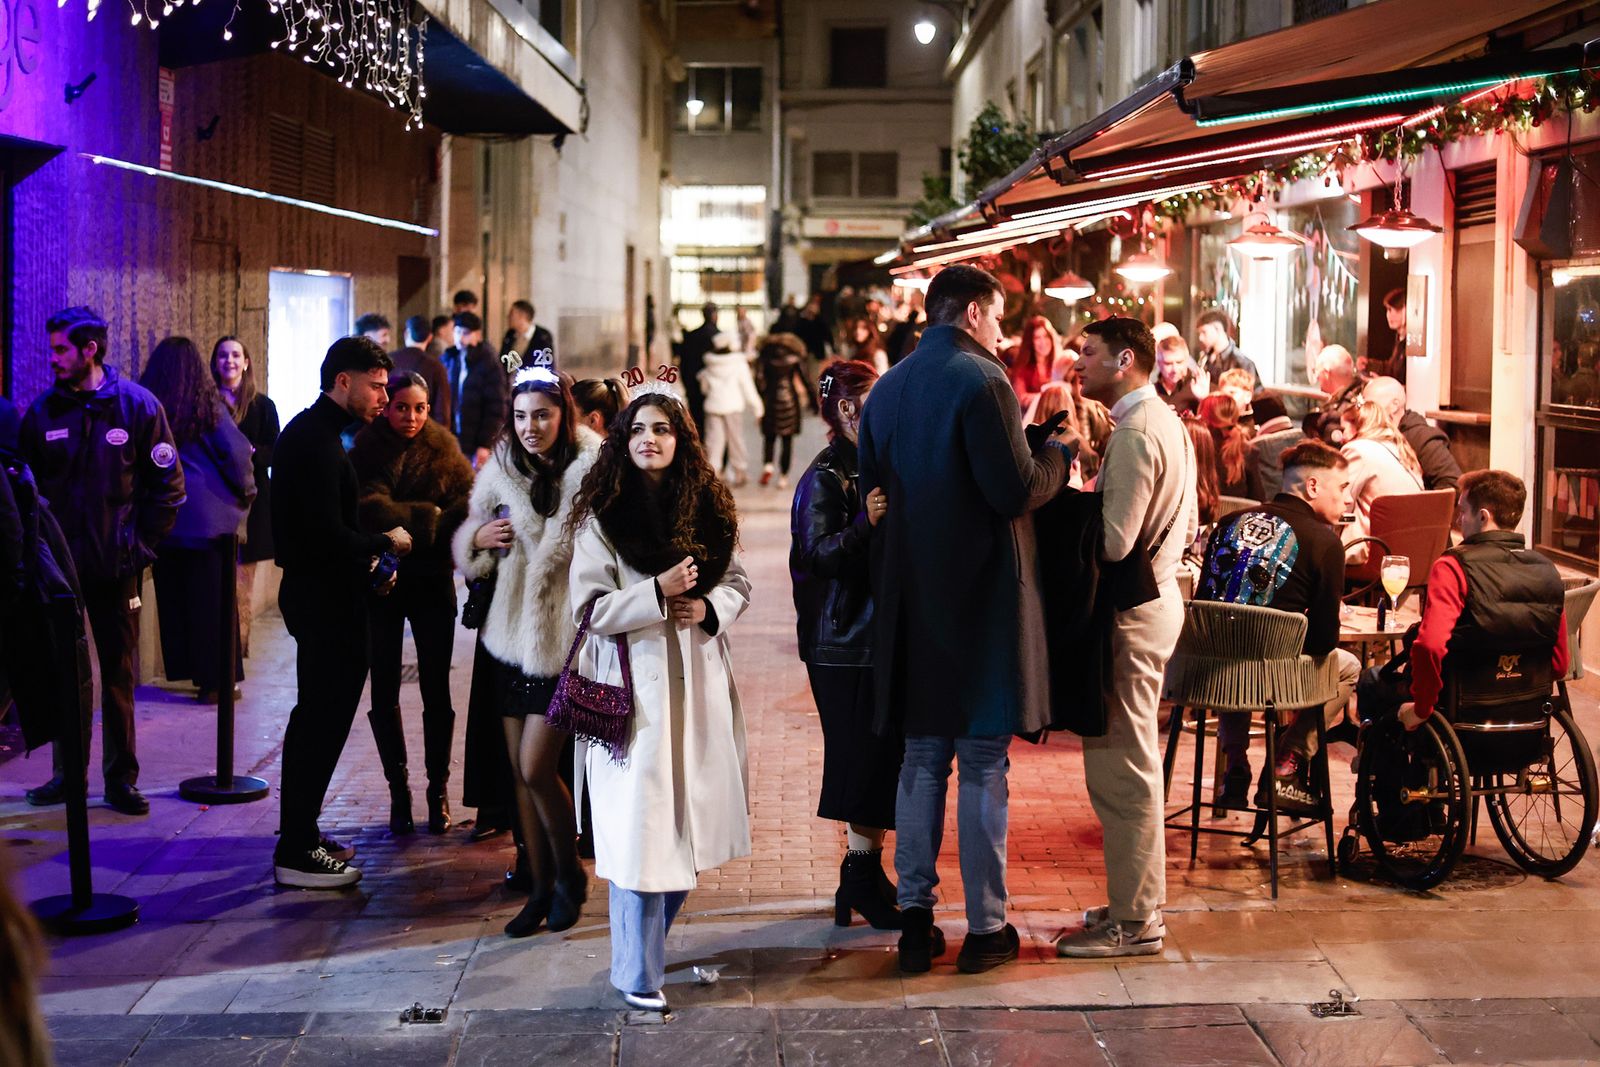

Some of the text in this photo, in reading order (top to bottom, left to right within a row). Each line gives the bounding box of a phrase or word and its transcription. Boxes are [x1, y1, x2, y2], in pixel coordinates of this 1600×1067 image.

[501, 347, 554, 374] 20 26
[621, 364, 679, 389] 20 26
